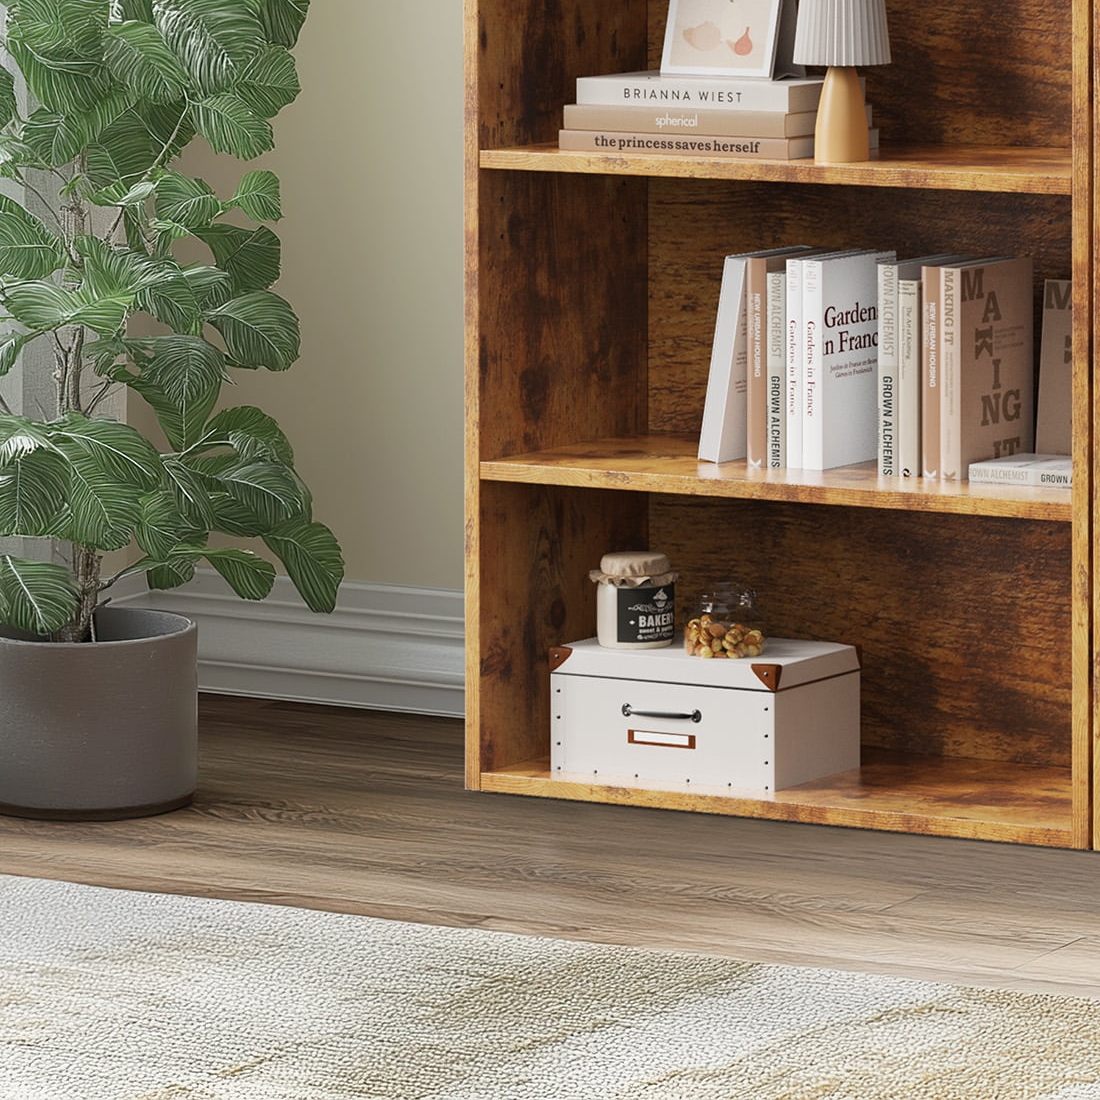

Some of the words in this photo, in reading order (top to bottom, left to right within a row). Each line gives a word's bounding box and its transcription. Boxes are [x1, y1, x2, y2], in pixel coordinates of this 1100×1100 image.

[623, 88, 691, 100] BRIANNA
[698, 91, 742, 103] WIEST
[655, 113, 699, 129] spherical
[594, 135, 617, 147] the
[618, 136, 674, 151] princess
[675, 141, 711, 151] saves
[713, 140, 761, 154] herself
[771, 273, 782, 302] ROWN
[883, 265, 895, 300] ROWN
[944, 270, 954, 327] MAKING
[753, 293, 761, 311] NEW
[824, 301, 879, 329] Garden
[928, 302, 936, 321] NEW
[753, 312, 761, 341] URBAN
[771, 304, 782, 358] ALCHEMIST
[788, 319, 798, 364] Gardens
[806, 320, 816, 365] Gardens
[838, 329, 878, 354] Franc
[883, 299, 895, 357] ALCHEMIST
[928, 321, 936, 350] URBAN
[944, 330, 954, 346] IT
[753, 341, 761, 377] HOUSING
[788, 366, 798, 377] in
[806, 367, 816, 379] in
[928, 350, 936, 388] HOUSING
[770, 375, 781, 414] GROWN
[788, 379, 798, 416] France
[806, 381, 816, 417] France
[882, 375, 893, 418] GROWN
[980, 388, 1022, 427] NG
[770, 415, 781, 468] ALCHEMIS
[882, 419, 893, 476] ALCHEMIS
[969, 467, 989, 479] OWN
[990, 469, 1029, 481] ALCHEMIST
[1041, 473, 1068, 484] GROWN
